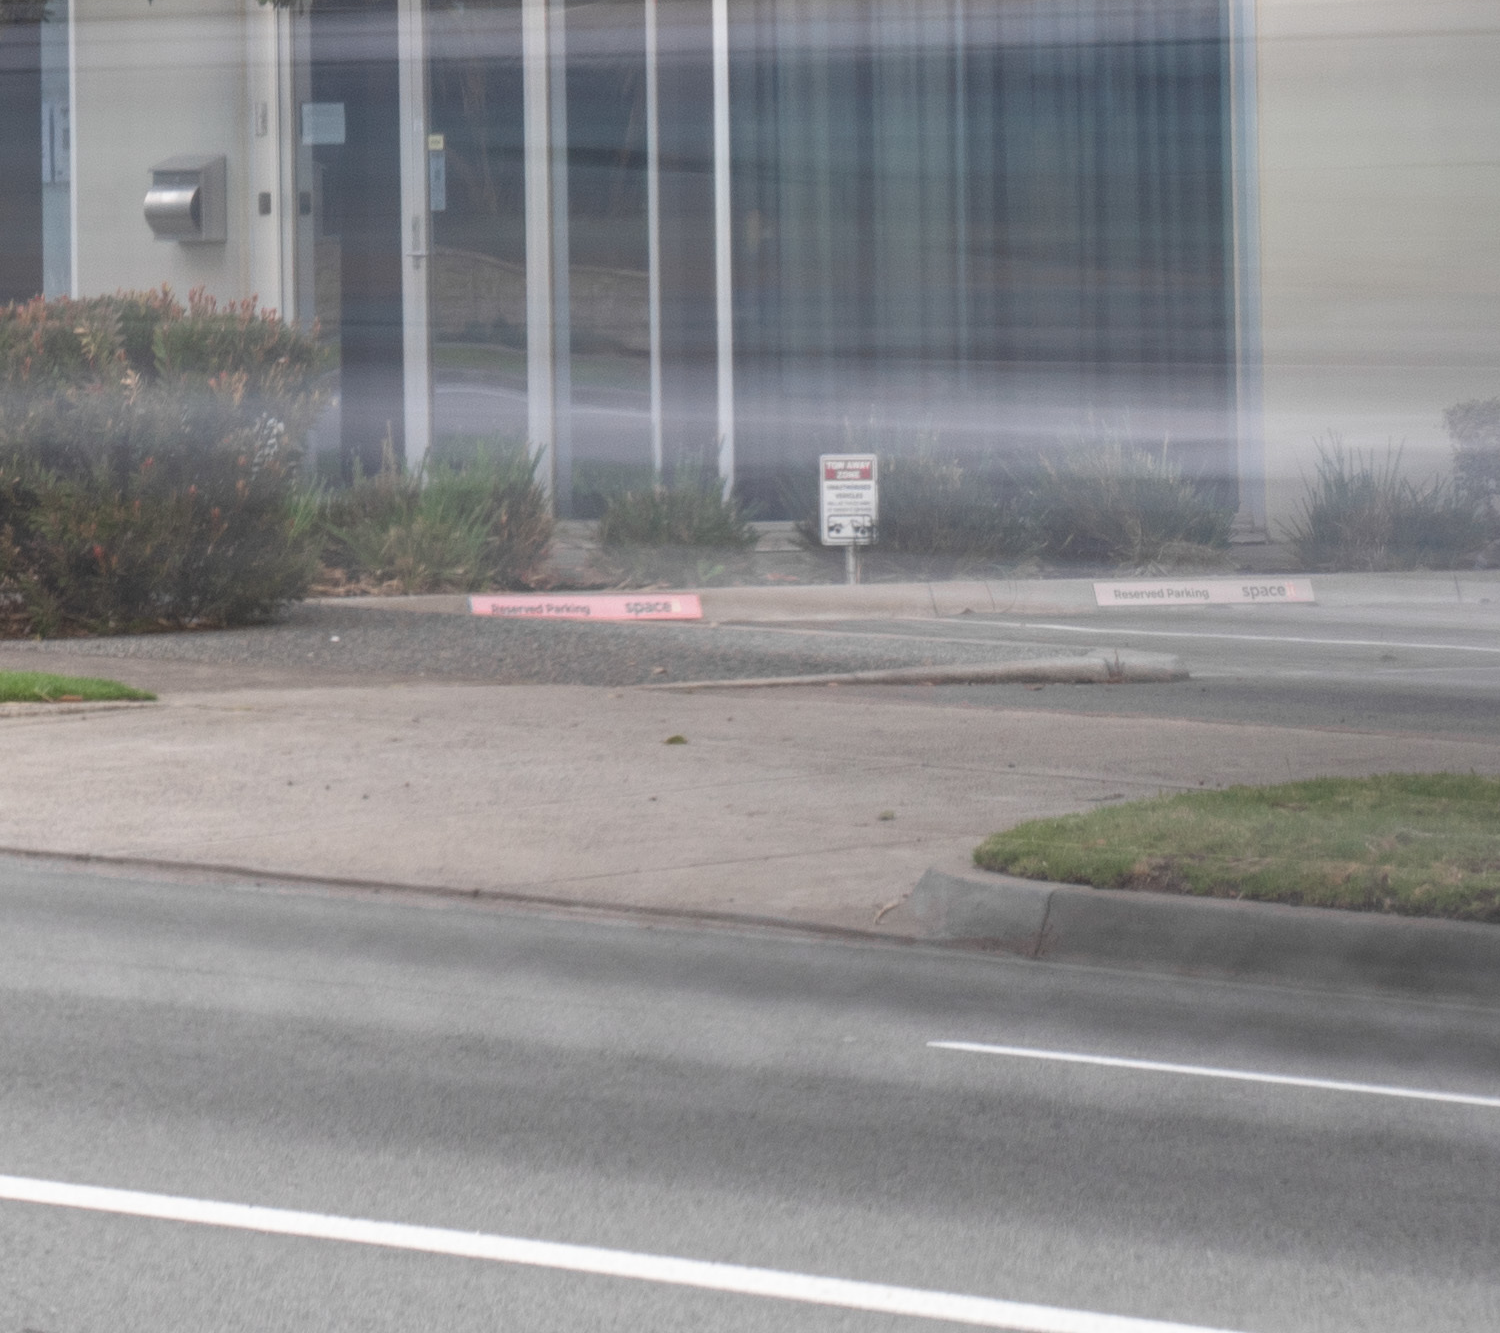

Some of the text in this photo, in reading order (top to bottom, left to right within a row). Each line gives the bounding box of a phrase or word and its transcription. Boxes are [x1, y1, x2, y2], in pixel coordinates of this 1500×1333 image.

[825, 460, 870, 470] TOW AWAY
[836, 470, 861, 480] ZONE
[1114, 589, 1164, 599] Reserved
[1166, 589, 1210, 600] Parking
[491, 604, 544, 615] Reserved
[546, 604, 591, 616] Parking
